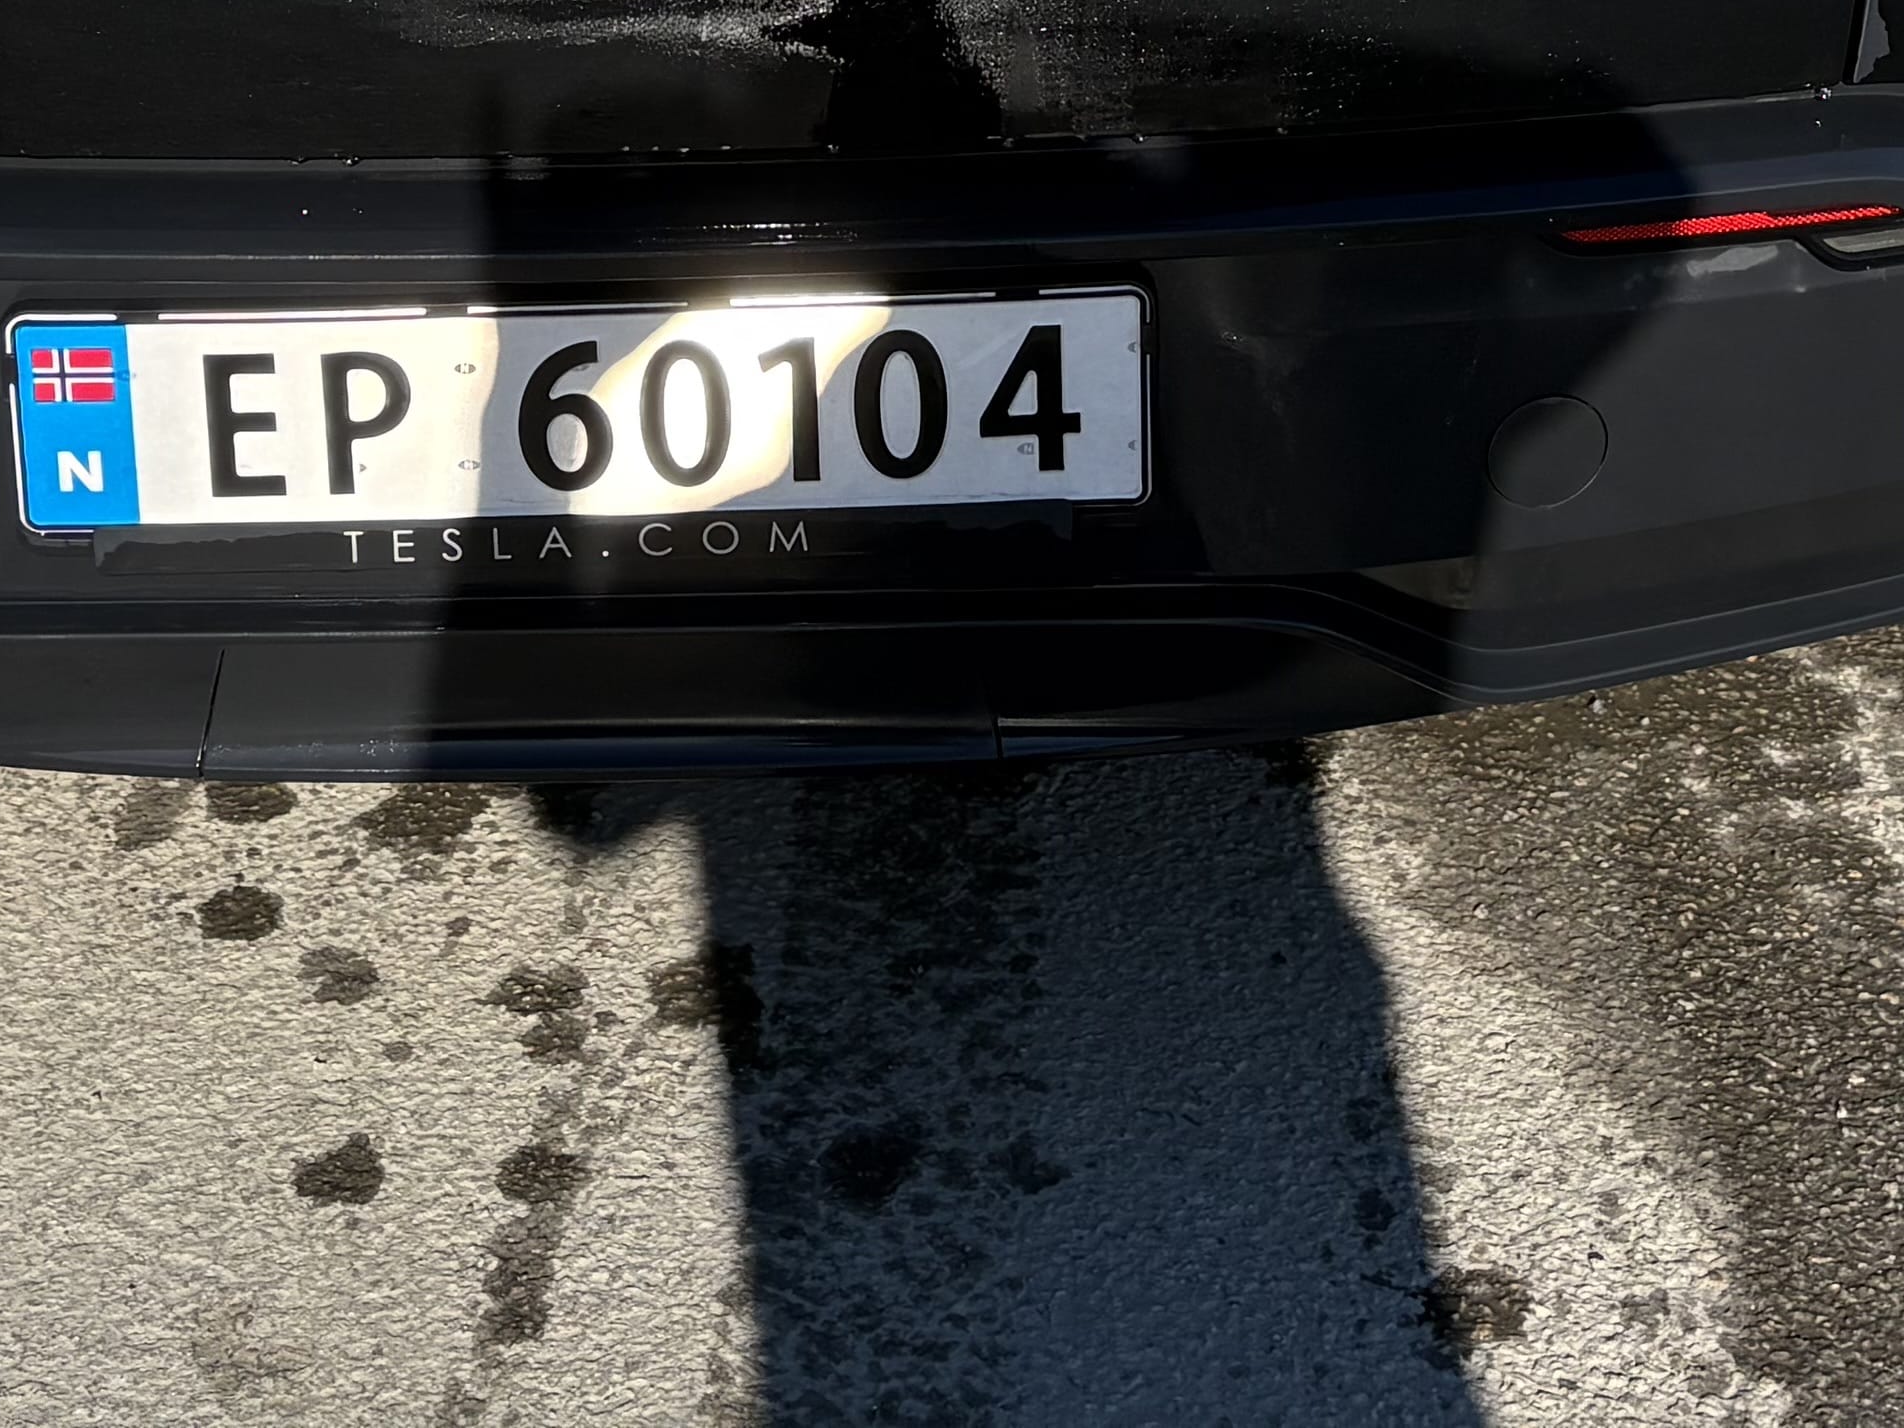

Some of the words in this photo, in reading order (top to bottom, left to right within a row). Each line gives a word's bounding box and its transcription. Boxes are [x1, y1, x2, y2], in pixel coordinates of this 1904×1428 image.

[202, 350, 413, 500] EP
[515, 323, 1082, 492] 60104
[58, 449, 105, 494] N
[342, 519, 811, 565] TESLA.COM
